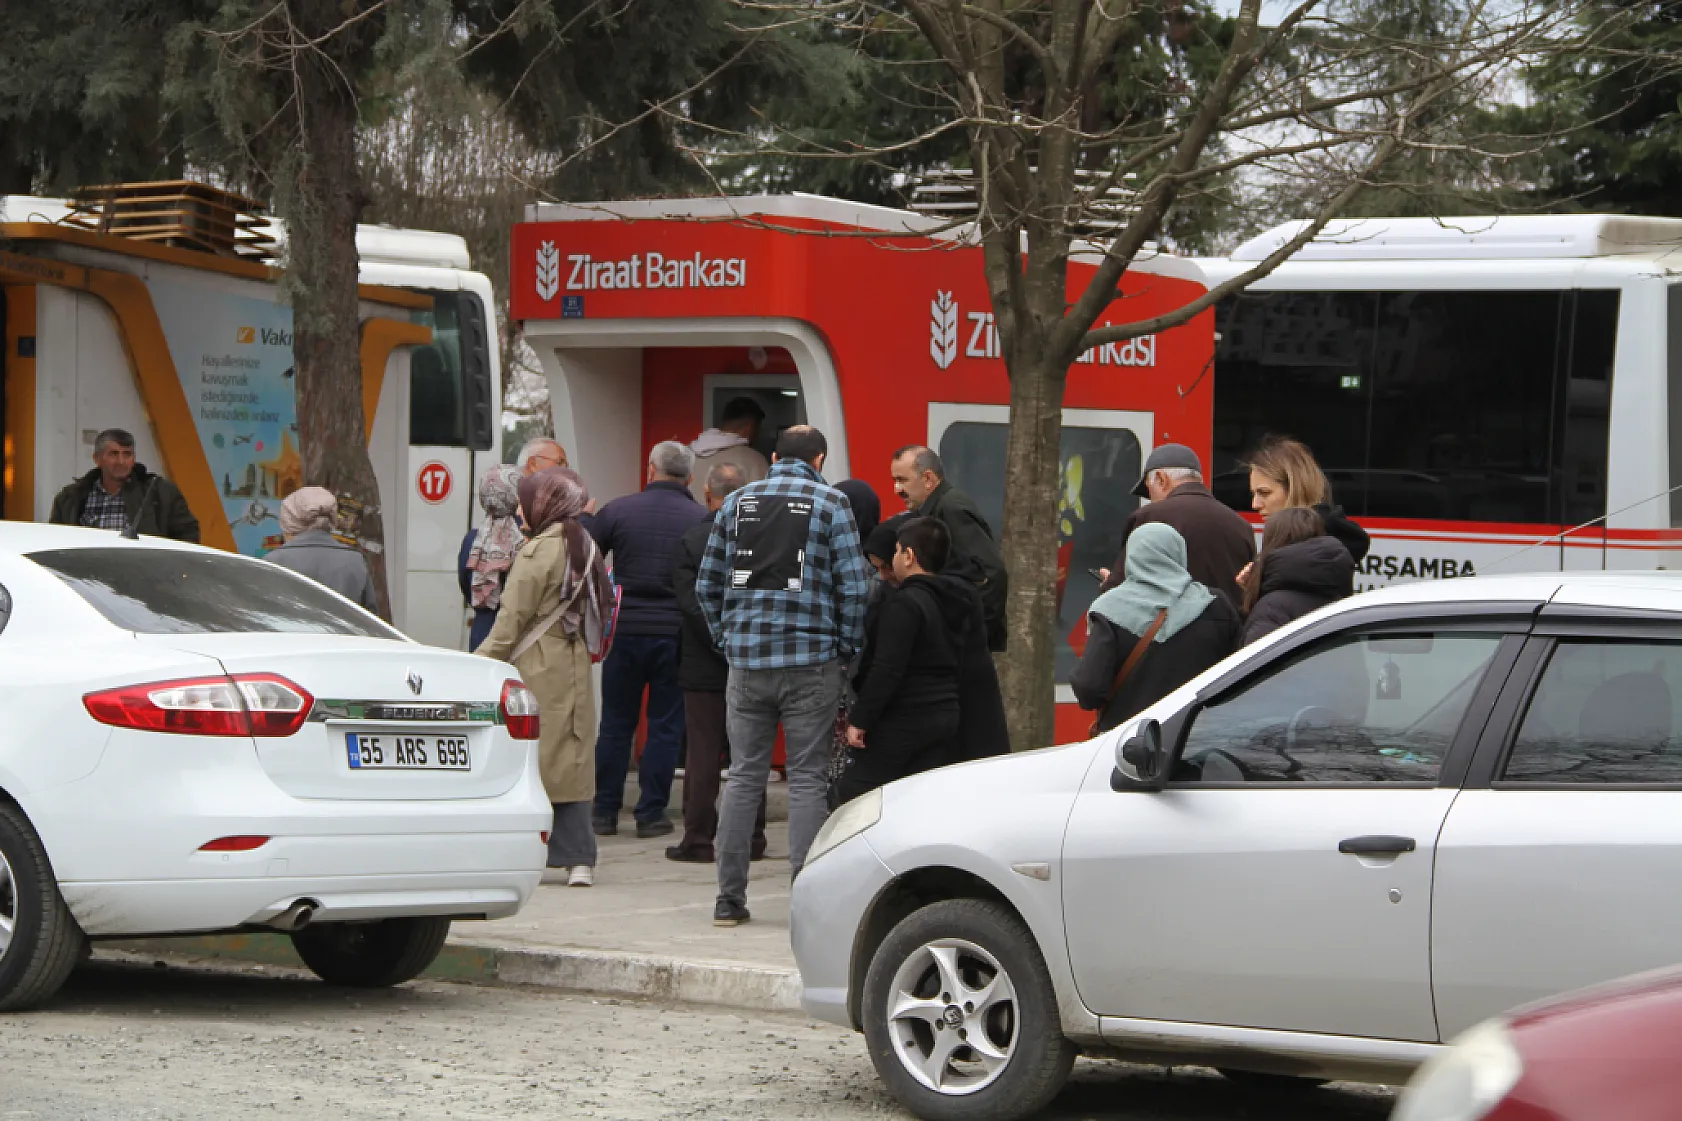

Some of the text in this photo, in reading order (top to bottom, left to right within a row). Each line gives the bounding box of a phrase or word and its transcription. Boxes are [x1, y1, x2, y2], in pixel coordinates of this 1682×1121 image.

[566, 251, 746, 290] Ziraat Bankası
[423, 470, 447, 494] 17
[1354, 555, 1477, 581] ARŞAMBA
[383, 707, 456, 719] FLUENCE
[360, 737, 383, 764] 55
[396, 738, 428, 765] ARS
[437, 739, 468, 766] 695
